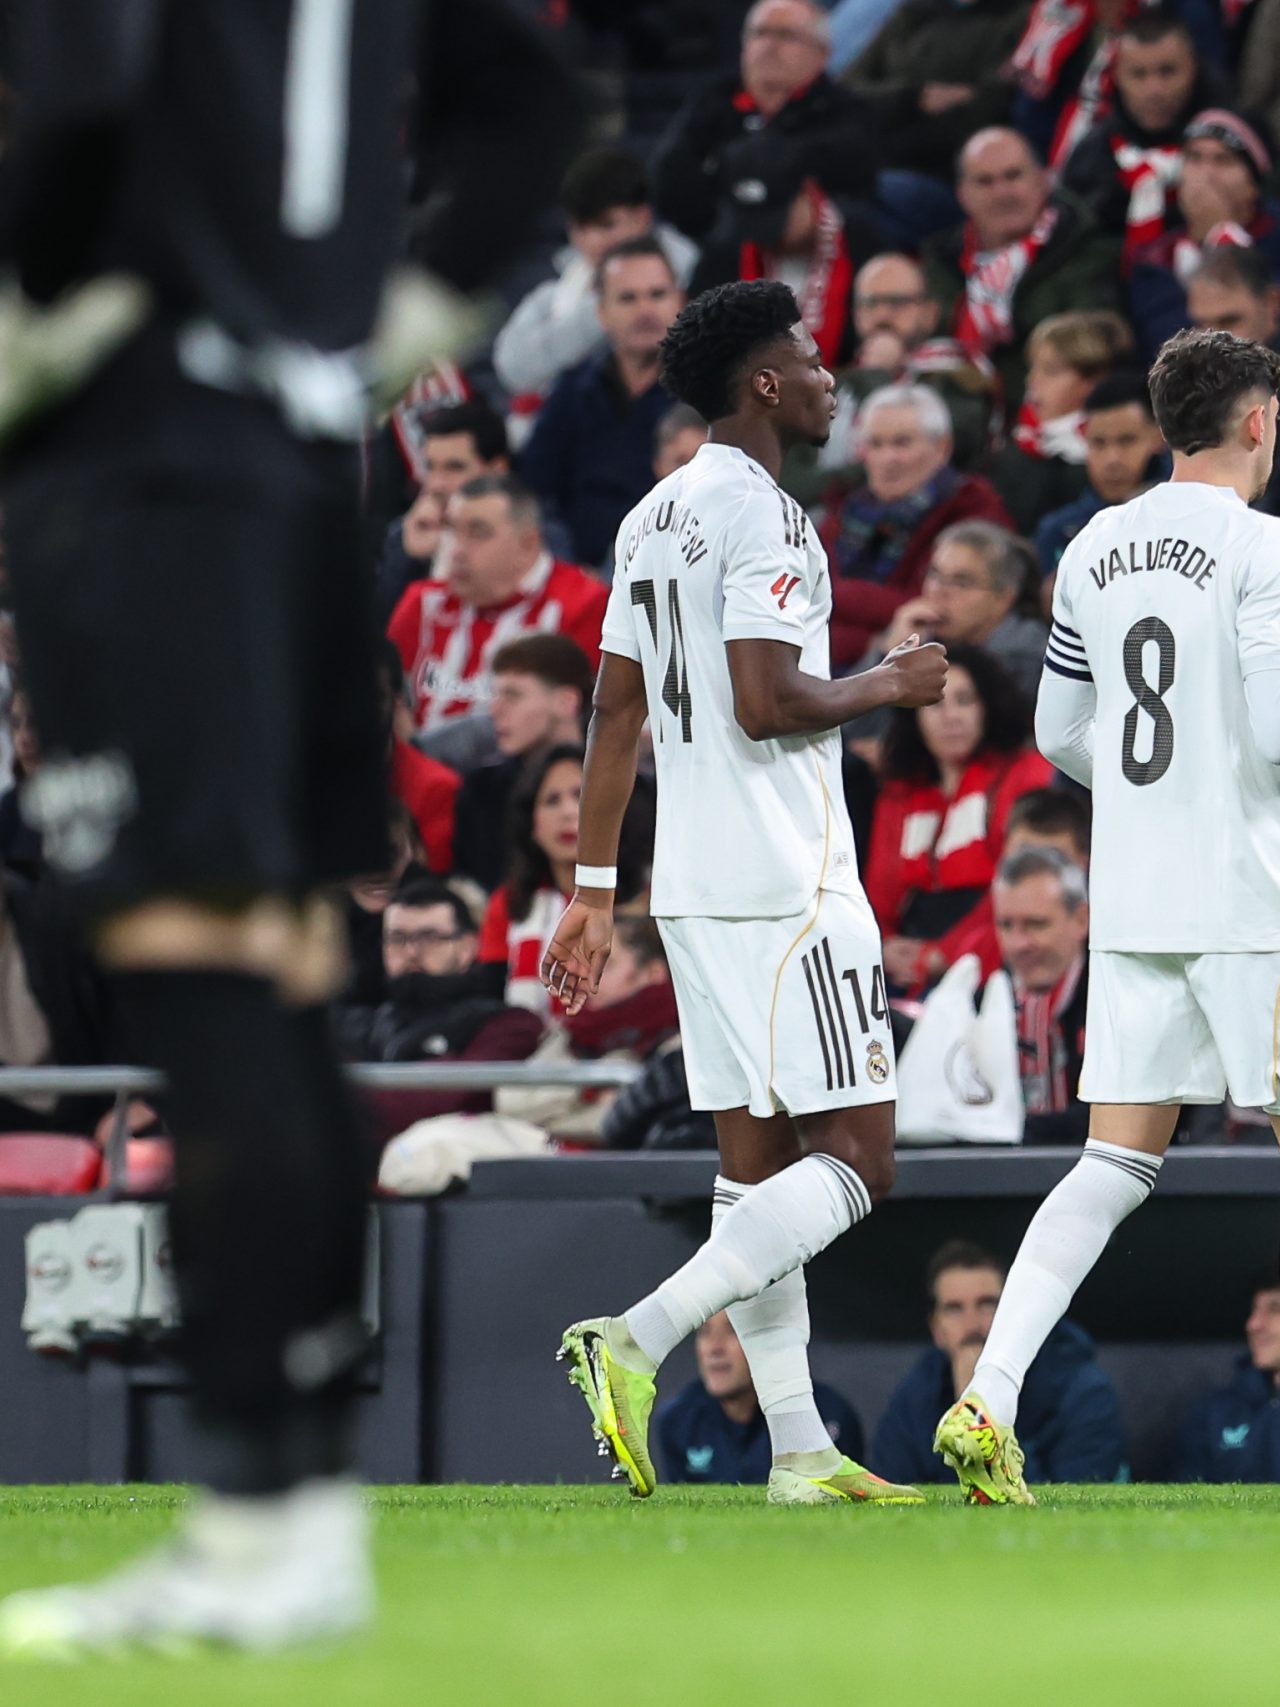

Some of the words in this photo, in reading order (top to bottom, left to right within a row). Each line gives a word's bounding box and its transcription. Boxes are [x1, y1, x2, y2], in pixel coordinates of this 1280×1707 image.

[1088, 537, 1217, 592] VALVERDE
[630, 578, 693, 744] 14
[1121, 615, 1176, 787] 8
[841, 964, 891, 1035] 14
